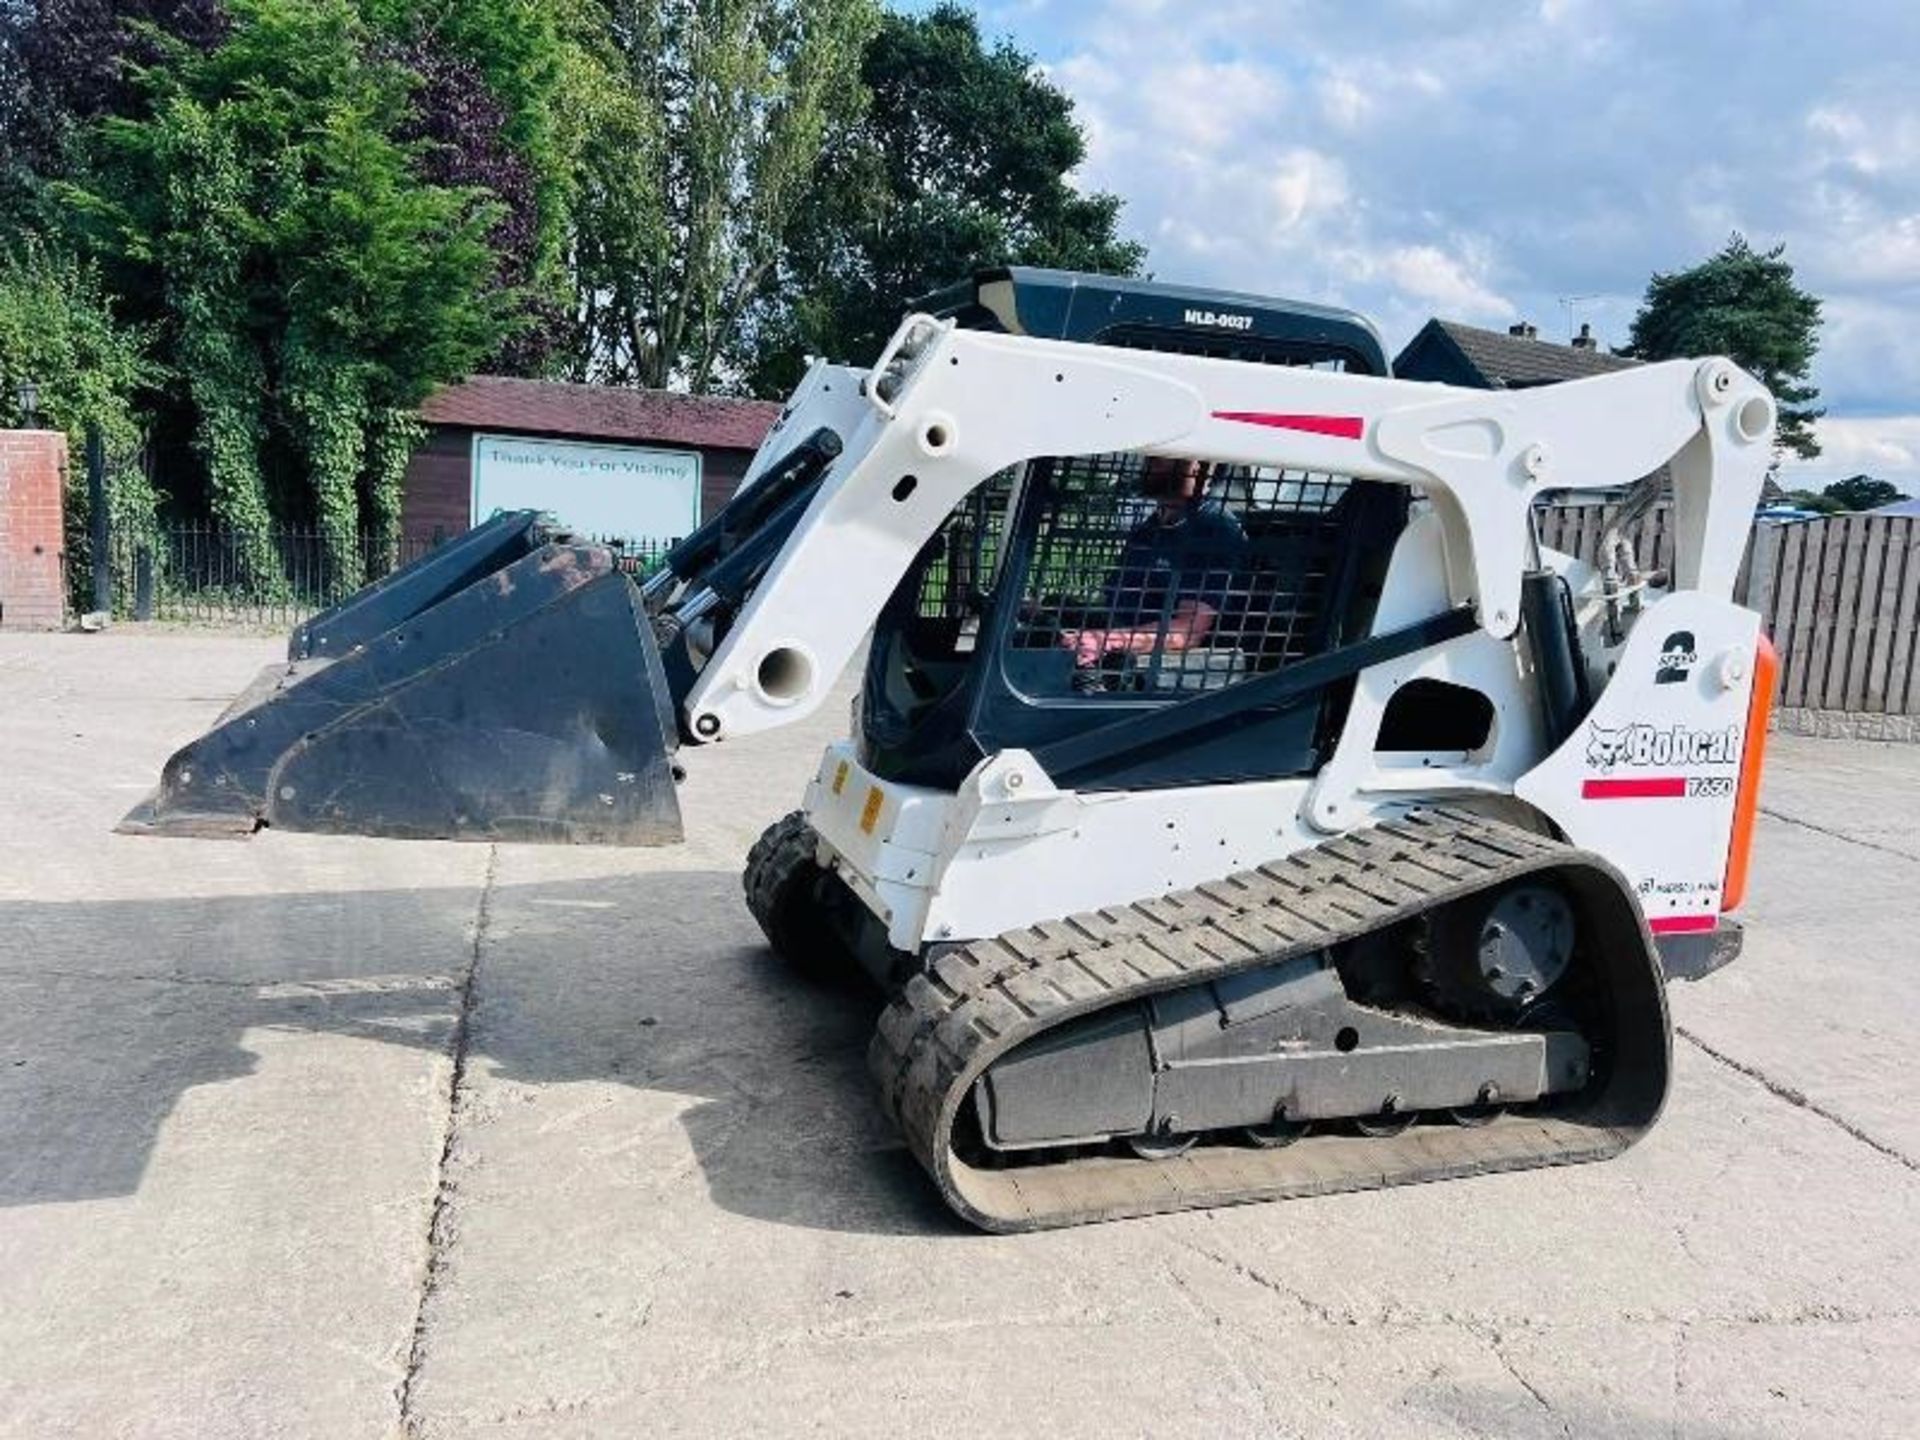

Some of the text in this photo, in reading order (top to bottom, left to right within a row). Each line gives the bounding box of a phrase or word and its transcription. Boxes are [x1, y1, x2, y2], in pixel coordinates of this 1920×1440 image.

[492, 450, 689, 480] Thank You For Visiting
[1654, 630, 1695, 684] 2
[1631, 723, 1740, 767] Bobcat
[1689, 777, 1734, 798] T650
